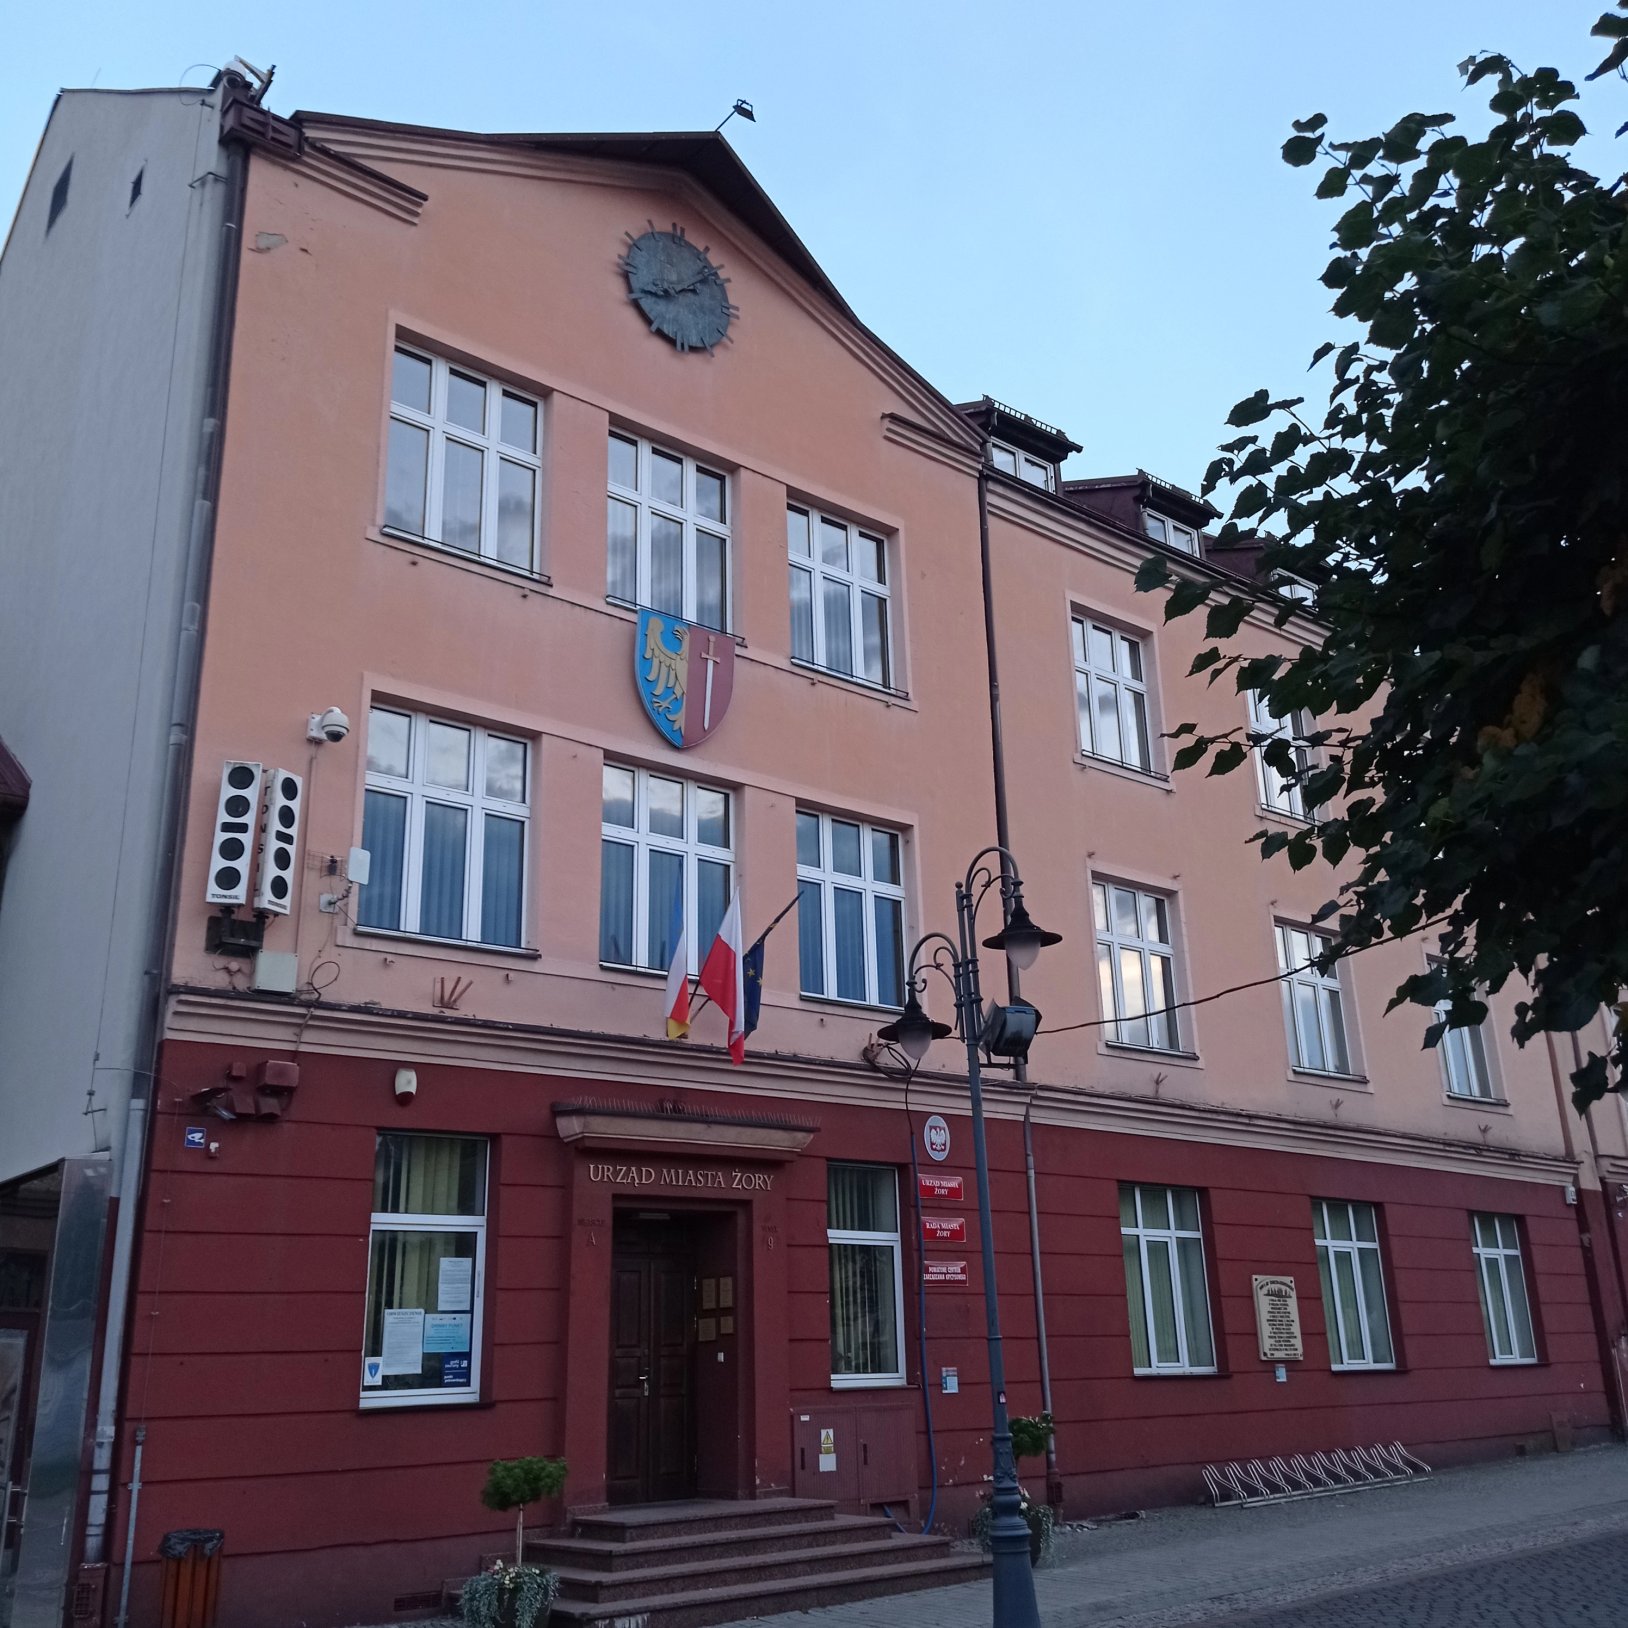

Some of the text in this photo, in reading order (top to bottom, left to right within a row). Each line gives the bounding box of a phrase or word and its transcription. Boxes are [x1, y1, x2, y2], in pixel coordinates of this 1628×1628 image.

[588, 1164, 774, 1191] URZĄD MIASTA ŻORY
[940, 1180, 959, 1188] MIASTA
[940, 1222, 960, 1231] MIASTA
[936, 1230, 951, 1238] ŻORY
